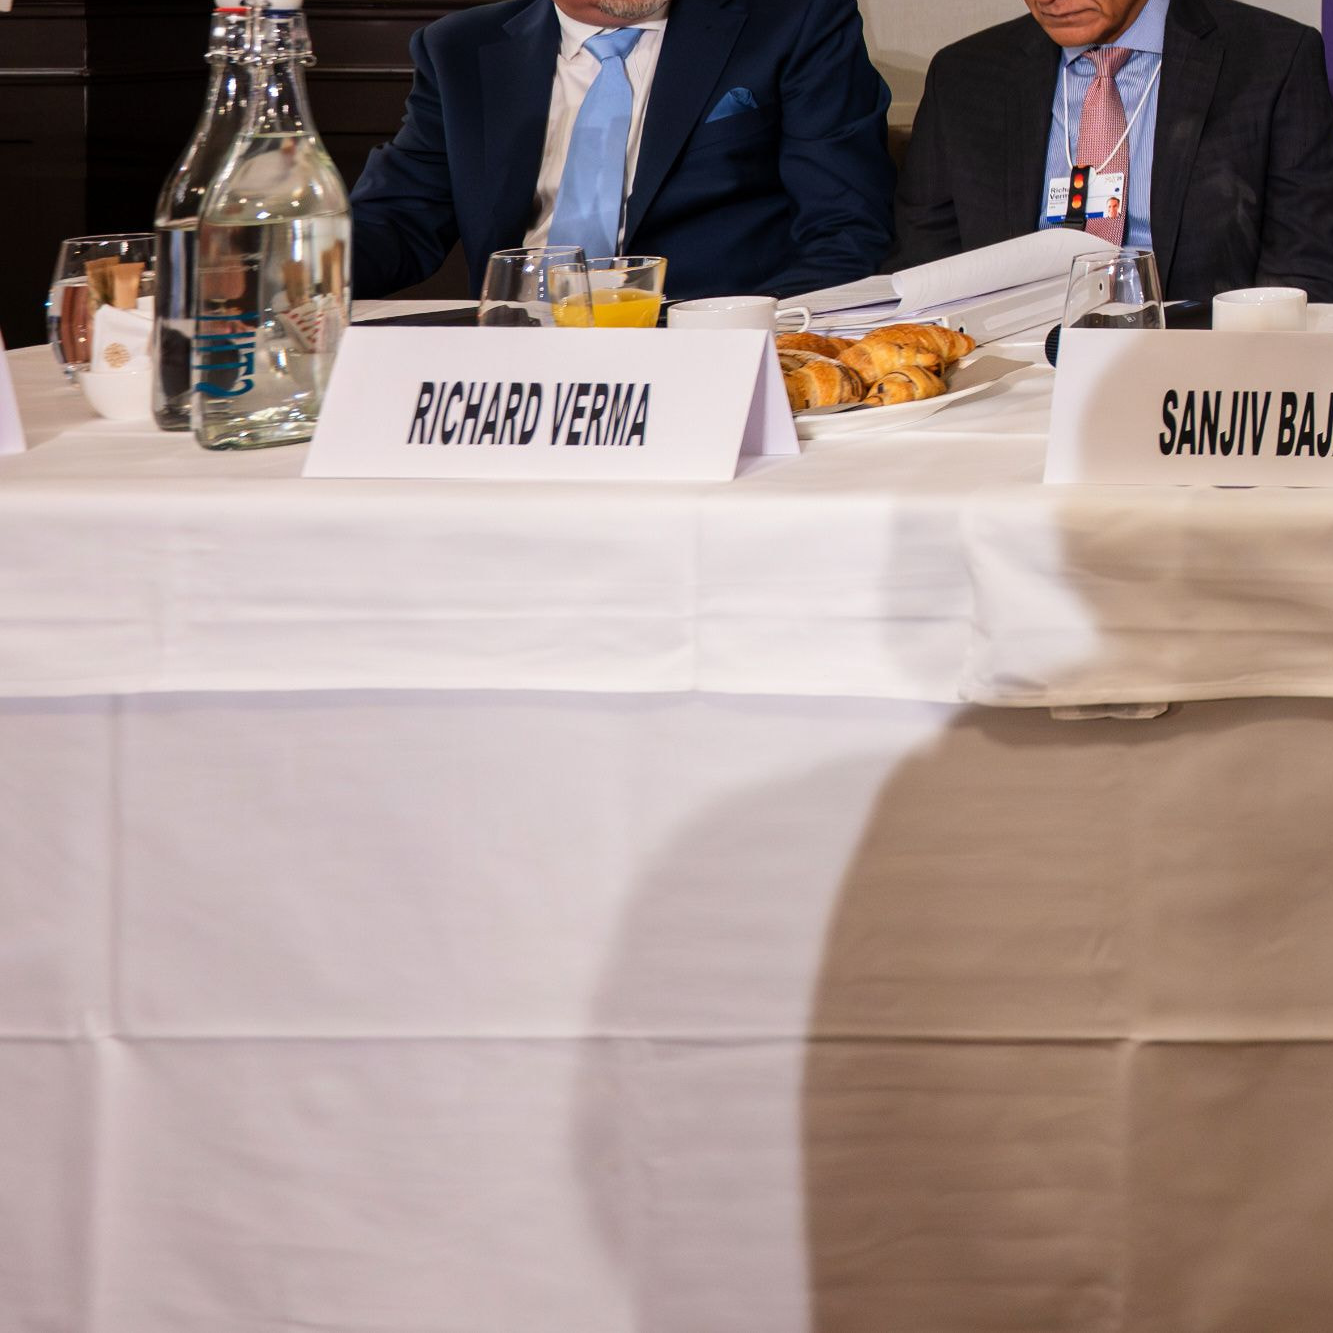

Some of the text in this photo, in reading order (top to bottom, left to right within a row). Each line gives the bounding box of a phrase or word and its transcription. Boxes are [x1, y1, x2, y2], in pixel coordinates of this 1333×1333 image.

[406, 381, 652, 447] RICHARD VERMA
[1158, 389, 1272, 458] SANJIV
